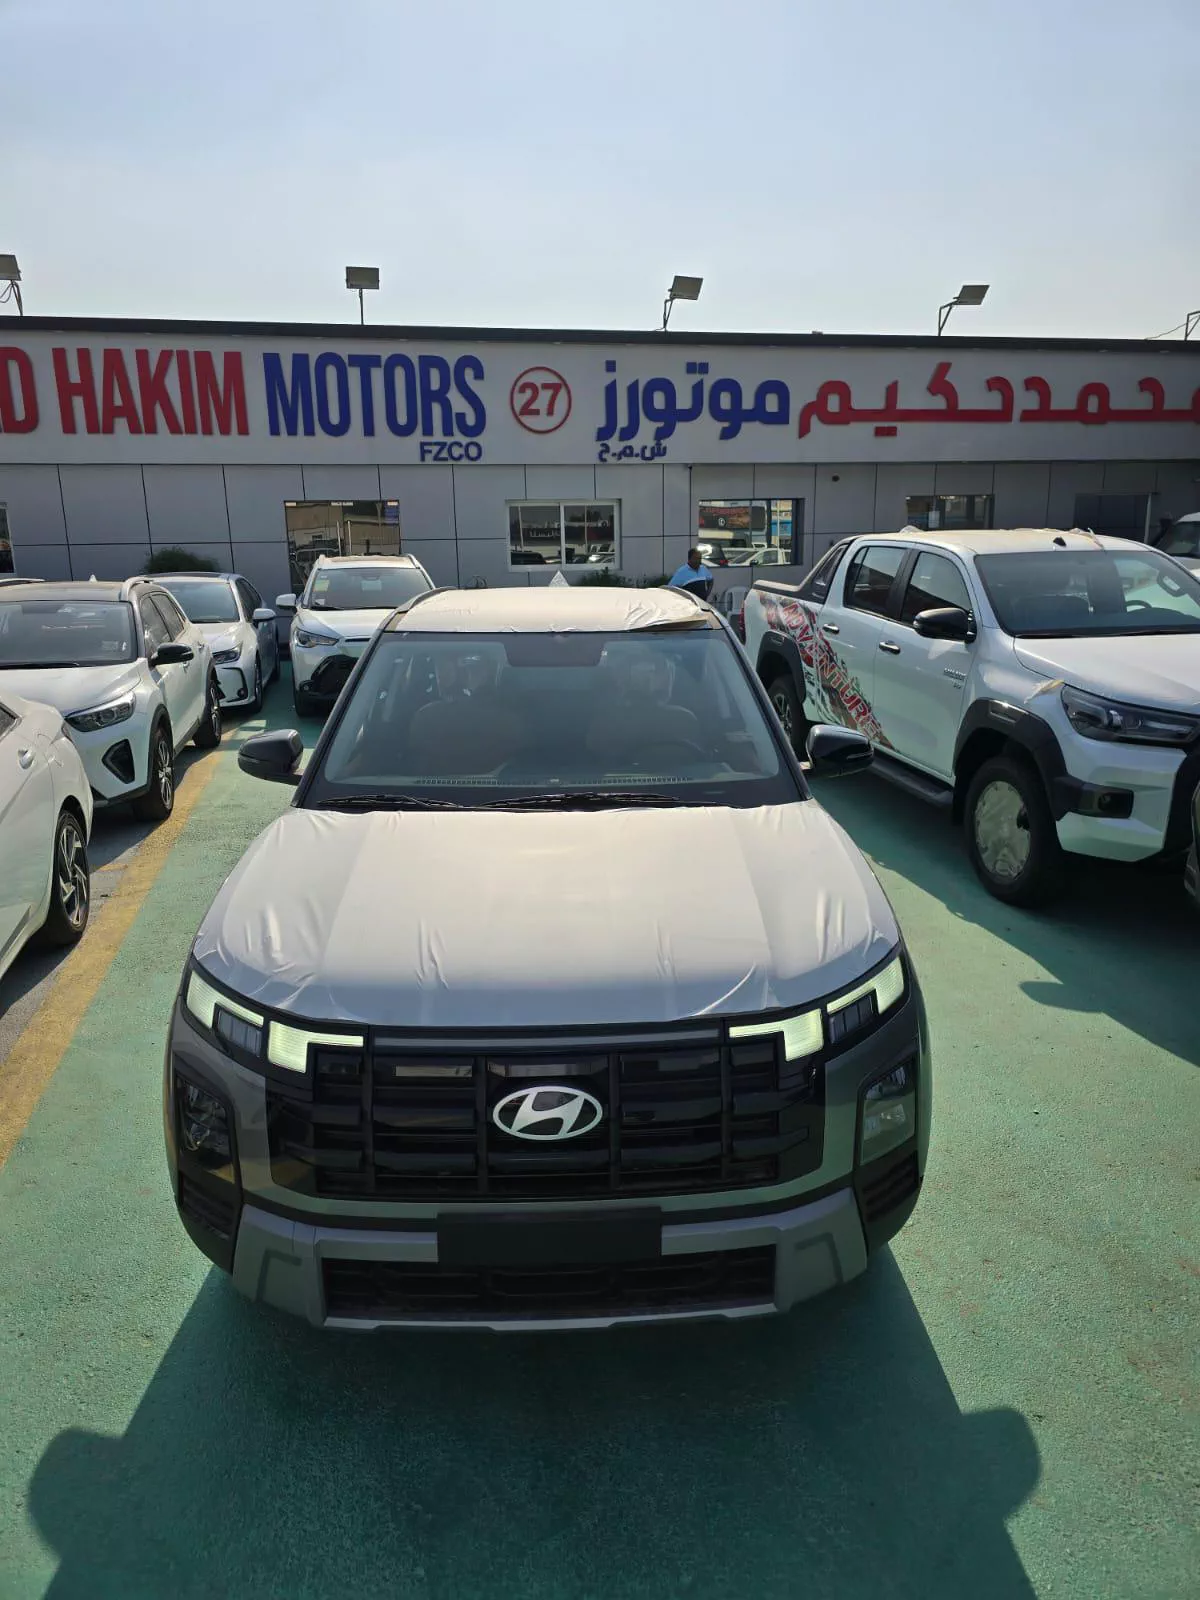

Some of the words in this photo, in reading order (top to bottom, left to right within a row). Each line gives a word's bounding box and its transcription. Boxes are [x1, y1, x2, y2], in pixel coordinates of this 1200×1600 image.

[0, 347, 39, 434] D
[51, 348, 249, 435] HAKIM
[263, 352, 487, 438] MOTORS
[518, 381, 562, 417] 27
[596, 360, 789, 441] موتورز
[799, 361, 1014, 439] حكيم
[1020, 375, 1200, 424] حمد
[420, 441, 483, 462] FZCO
[783, 602, 883, 741] ADVENTURE
